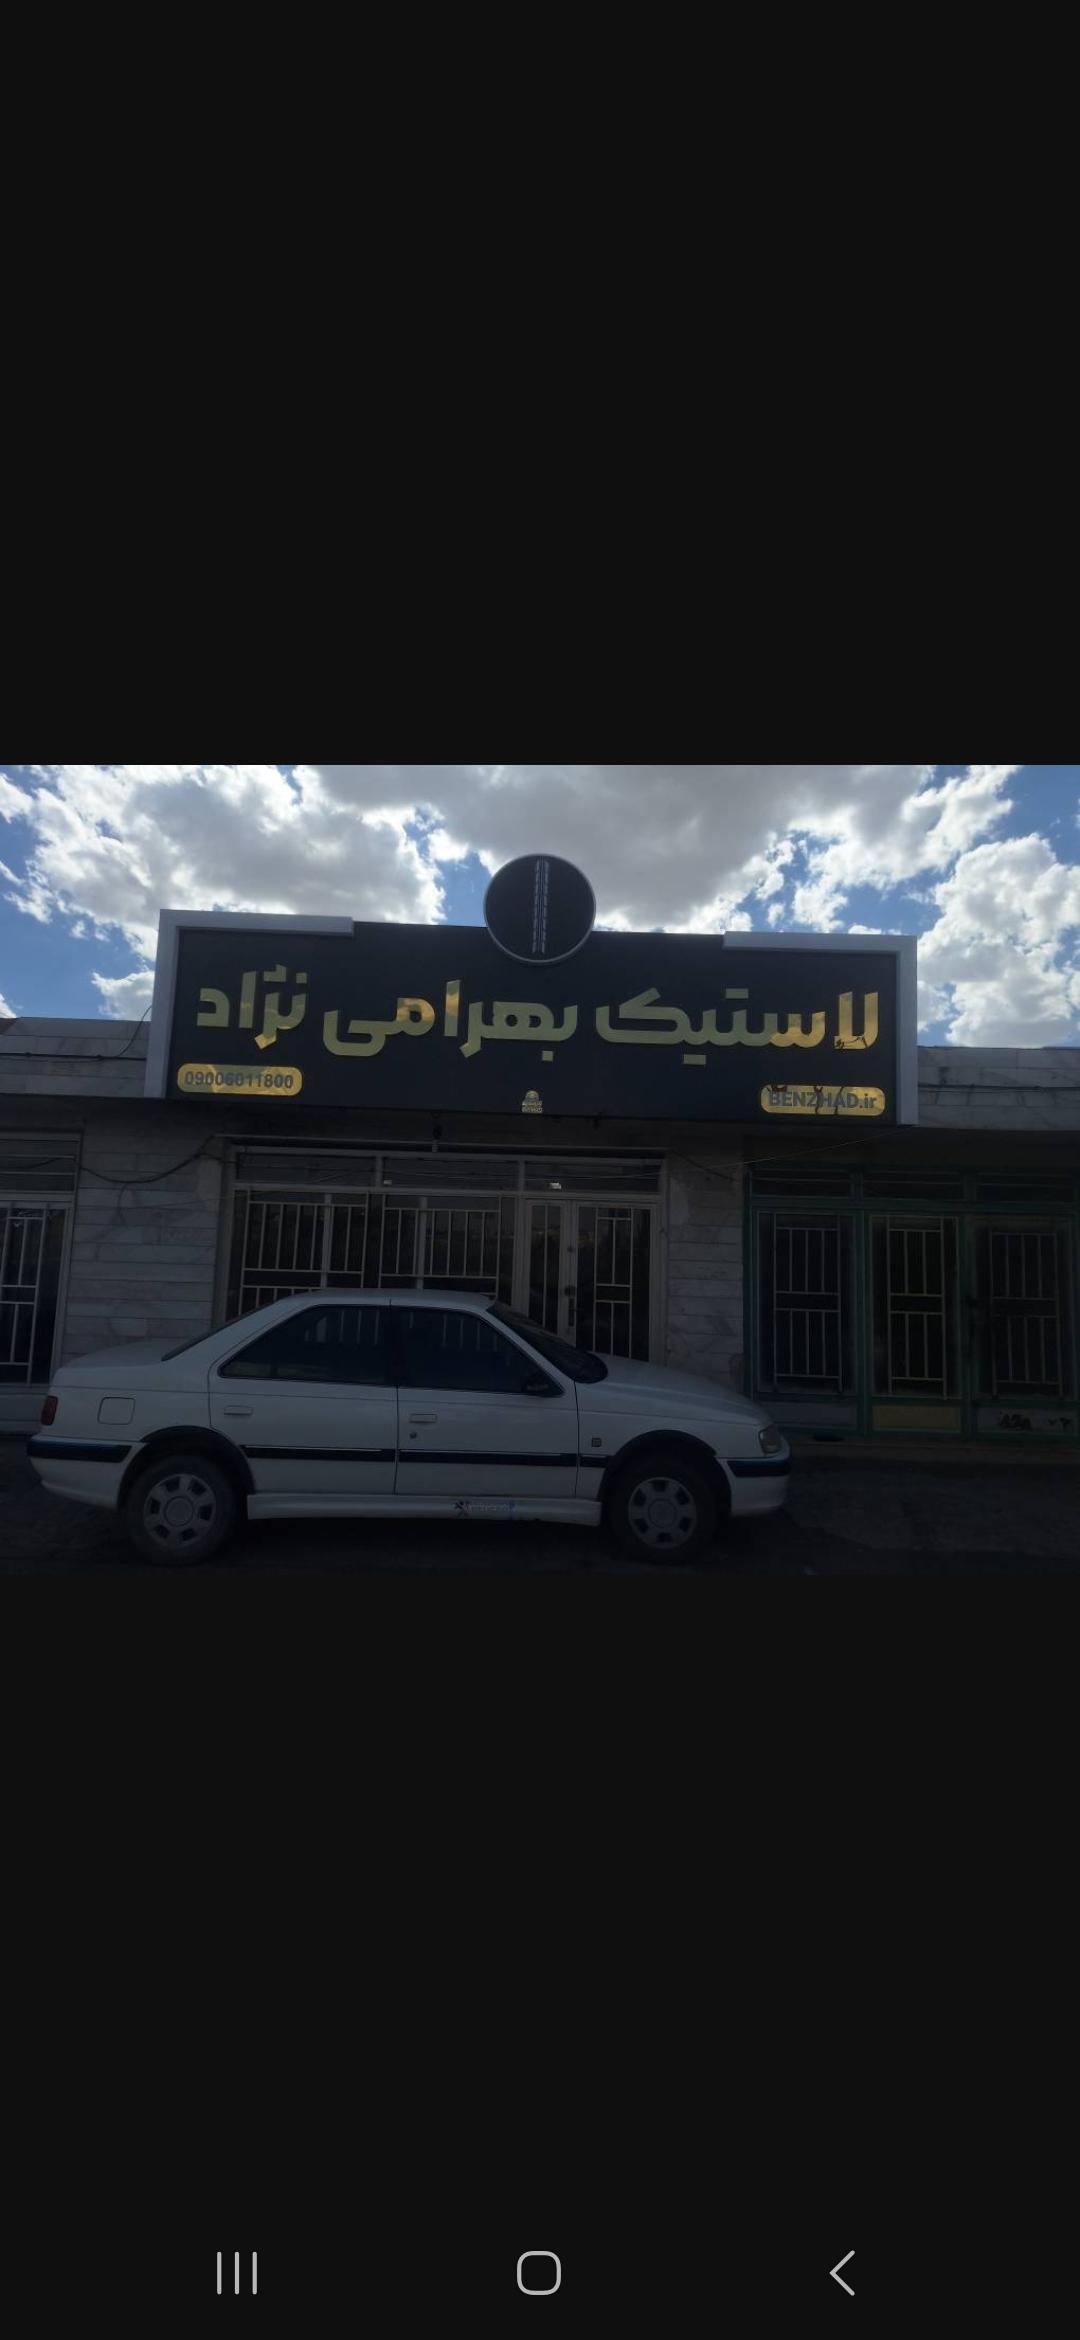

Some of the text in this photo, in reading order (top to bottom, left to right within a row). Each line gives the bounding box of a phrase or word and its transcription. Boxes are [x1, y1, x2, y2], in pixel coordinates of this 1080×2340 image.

[197, 964, 879, 1065] لاستیک بهرامی نژاد
[184, 1071, 294, 1089] 09006011800
[768, 1091, 877, 1109] BENZHAD.ir
